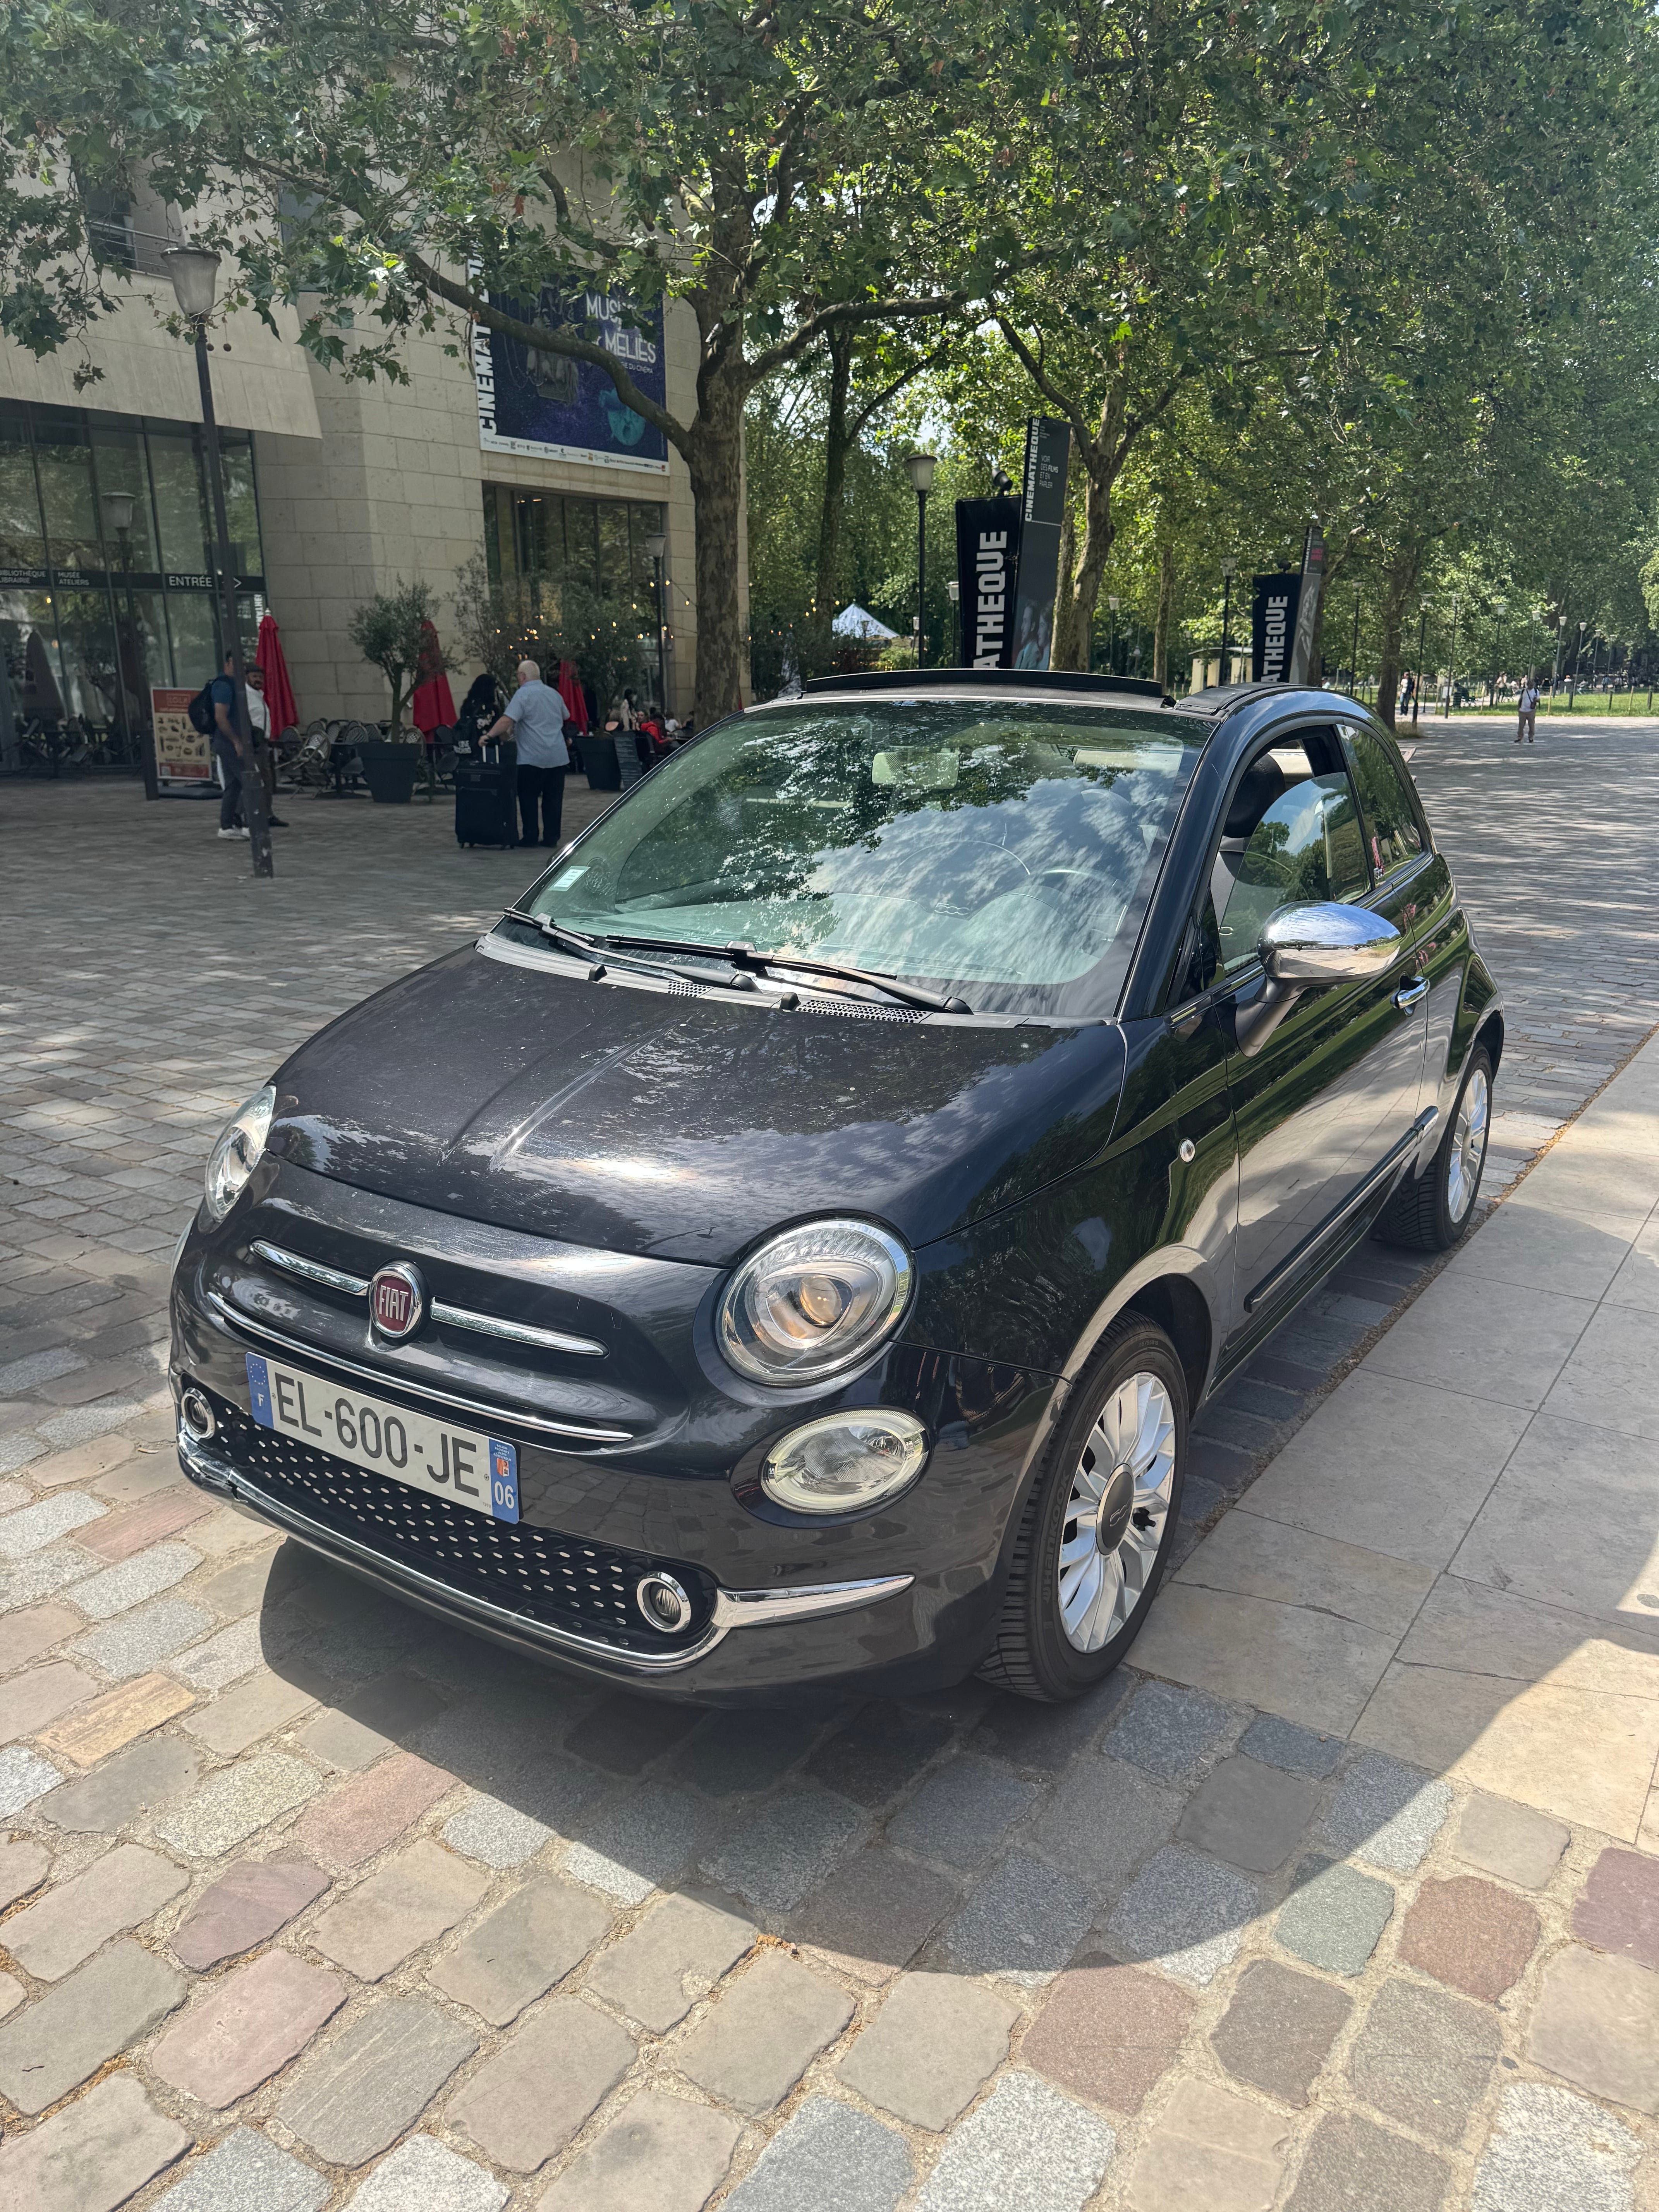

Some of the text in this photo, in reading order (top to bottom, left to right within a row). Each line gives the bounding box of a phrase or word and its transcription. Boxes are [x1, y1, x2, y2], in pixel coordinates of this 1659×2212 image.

[586, 292, 637, 324] MUS
[1025, 418, 1040, 522] CINEMATHEQUE
[1048, 465, 1058, 473] FILMS
[168, 575, 213, 587] ENTRÉE
[378, 1285, 409, 1322] FIAT
[258, 1394, 264, 1407] F
[275, 1372, 479, 1498] EL-600-JE
[494, 1481, 514, 1509] 06
